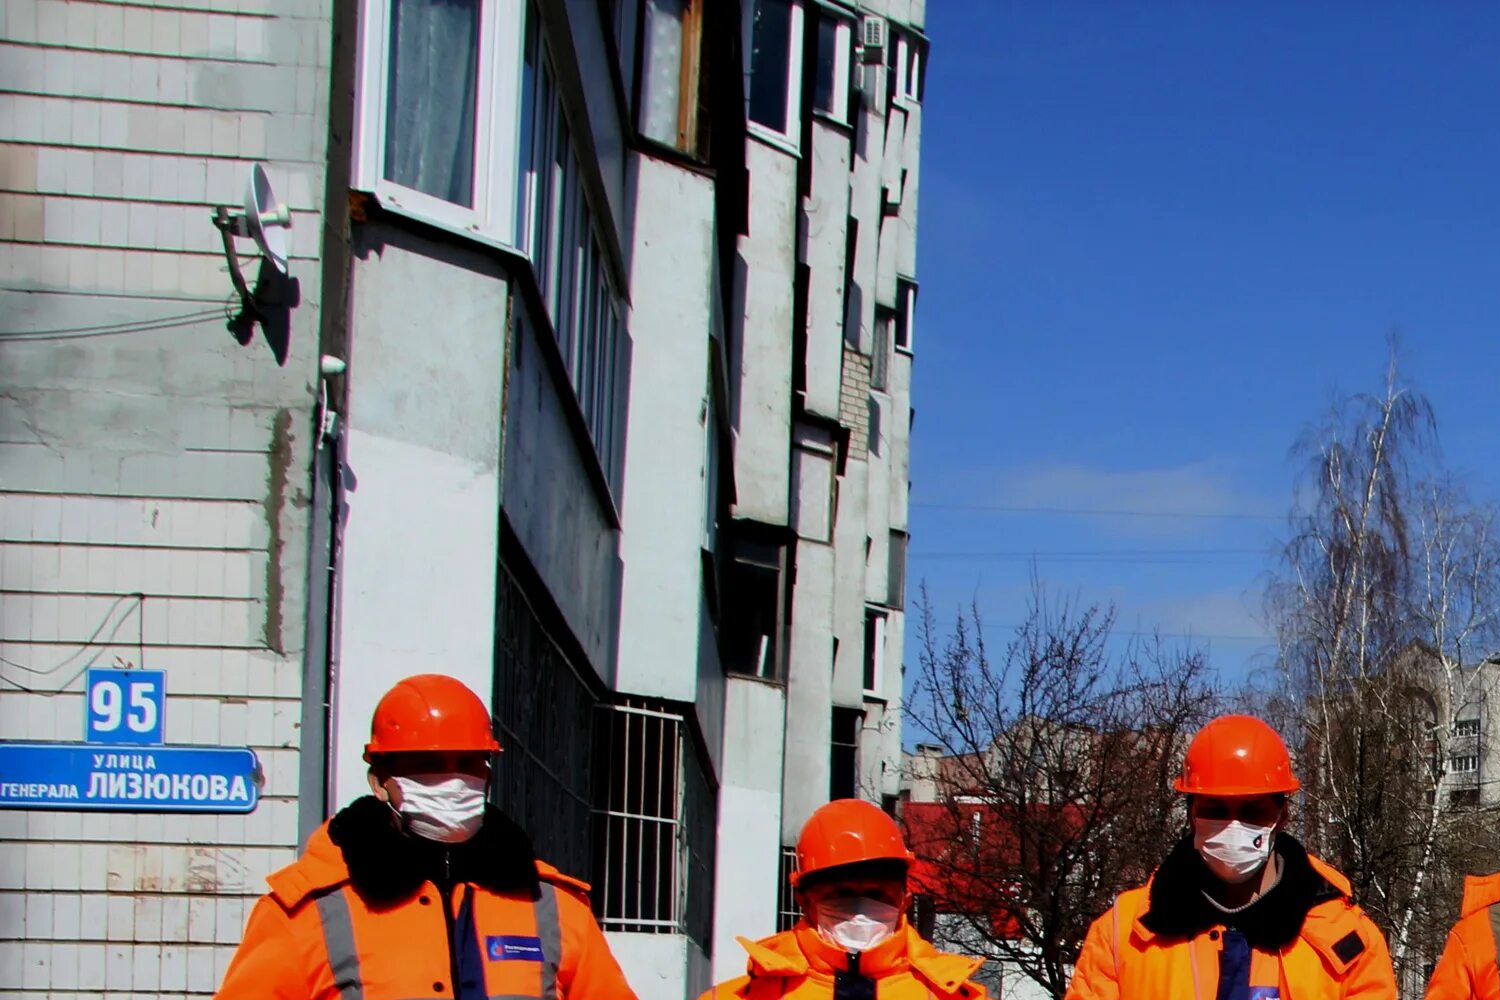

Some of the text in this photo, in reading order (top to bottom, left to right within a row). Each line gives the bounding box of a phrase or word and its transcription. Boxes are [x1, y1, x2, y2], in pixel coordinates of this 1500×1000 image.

[92, 681, 157, 732] 95
[94, 754, 156, 770] УЛИЦА
[1, 772, 249, 801] ГЕНЕРАЛА ЛИЗЮКОВА
